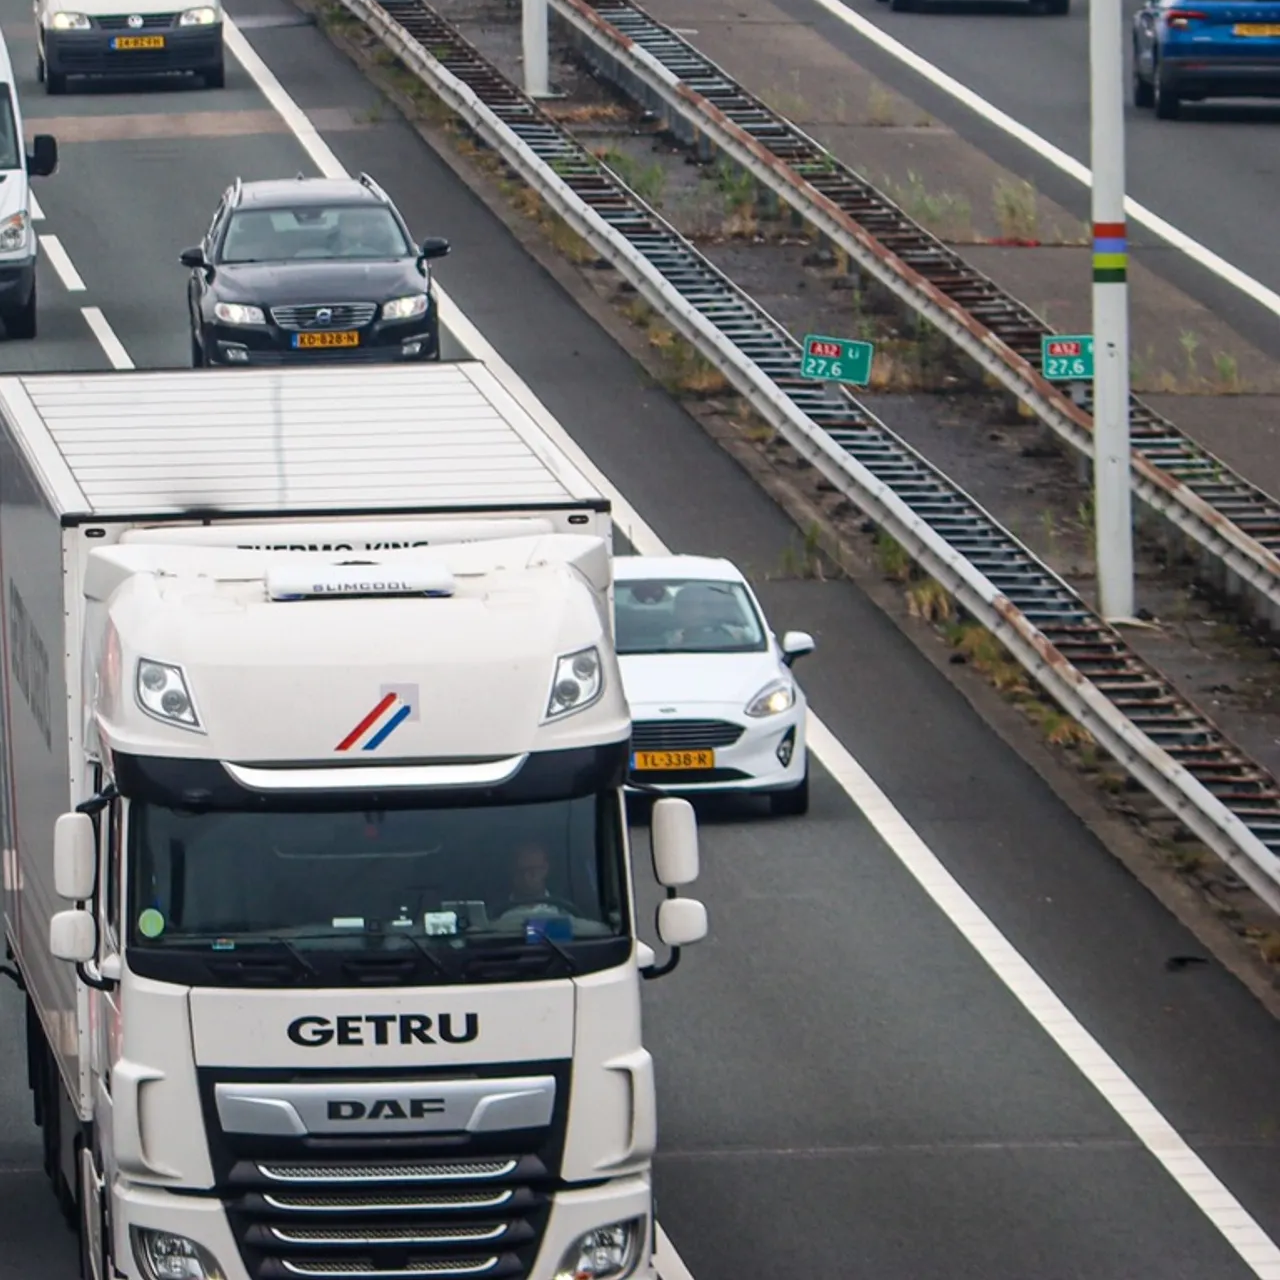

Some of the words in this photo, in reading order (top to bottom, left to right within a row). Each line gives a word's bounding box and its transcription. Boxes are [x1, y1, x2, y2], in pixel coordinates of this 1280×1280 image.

[312, 582, 413, 593] SLIMCOOL
[642, 751, 707, 767] TL-338-R
[286, 1012, 479, 1047] GETRU
[326, 1098, 445, 1120] DAF
